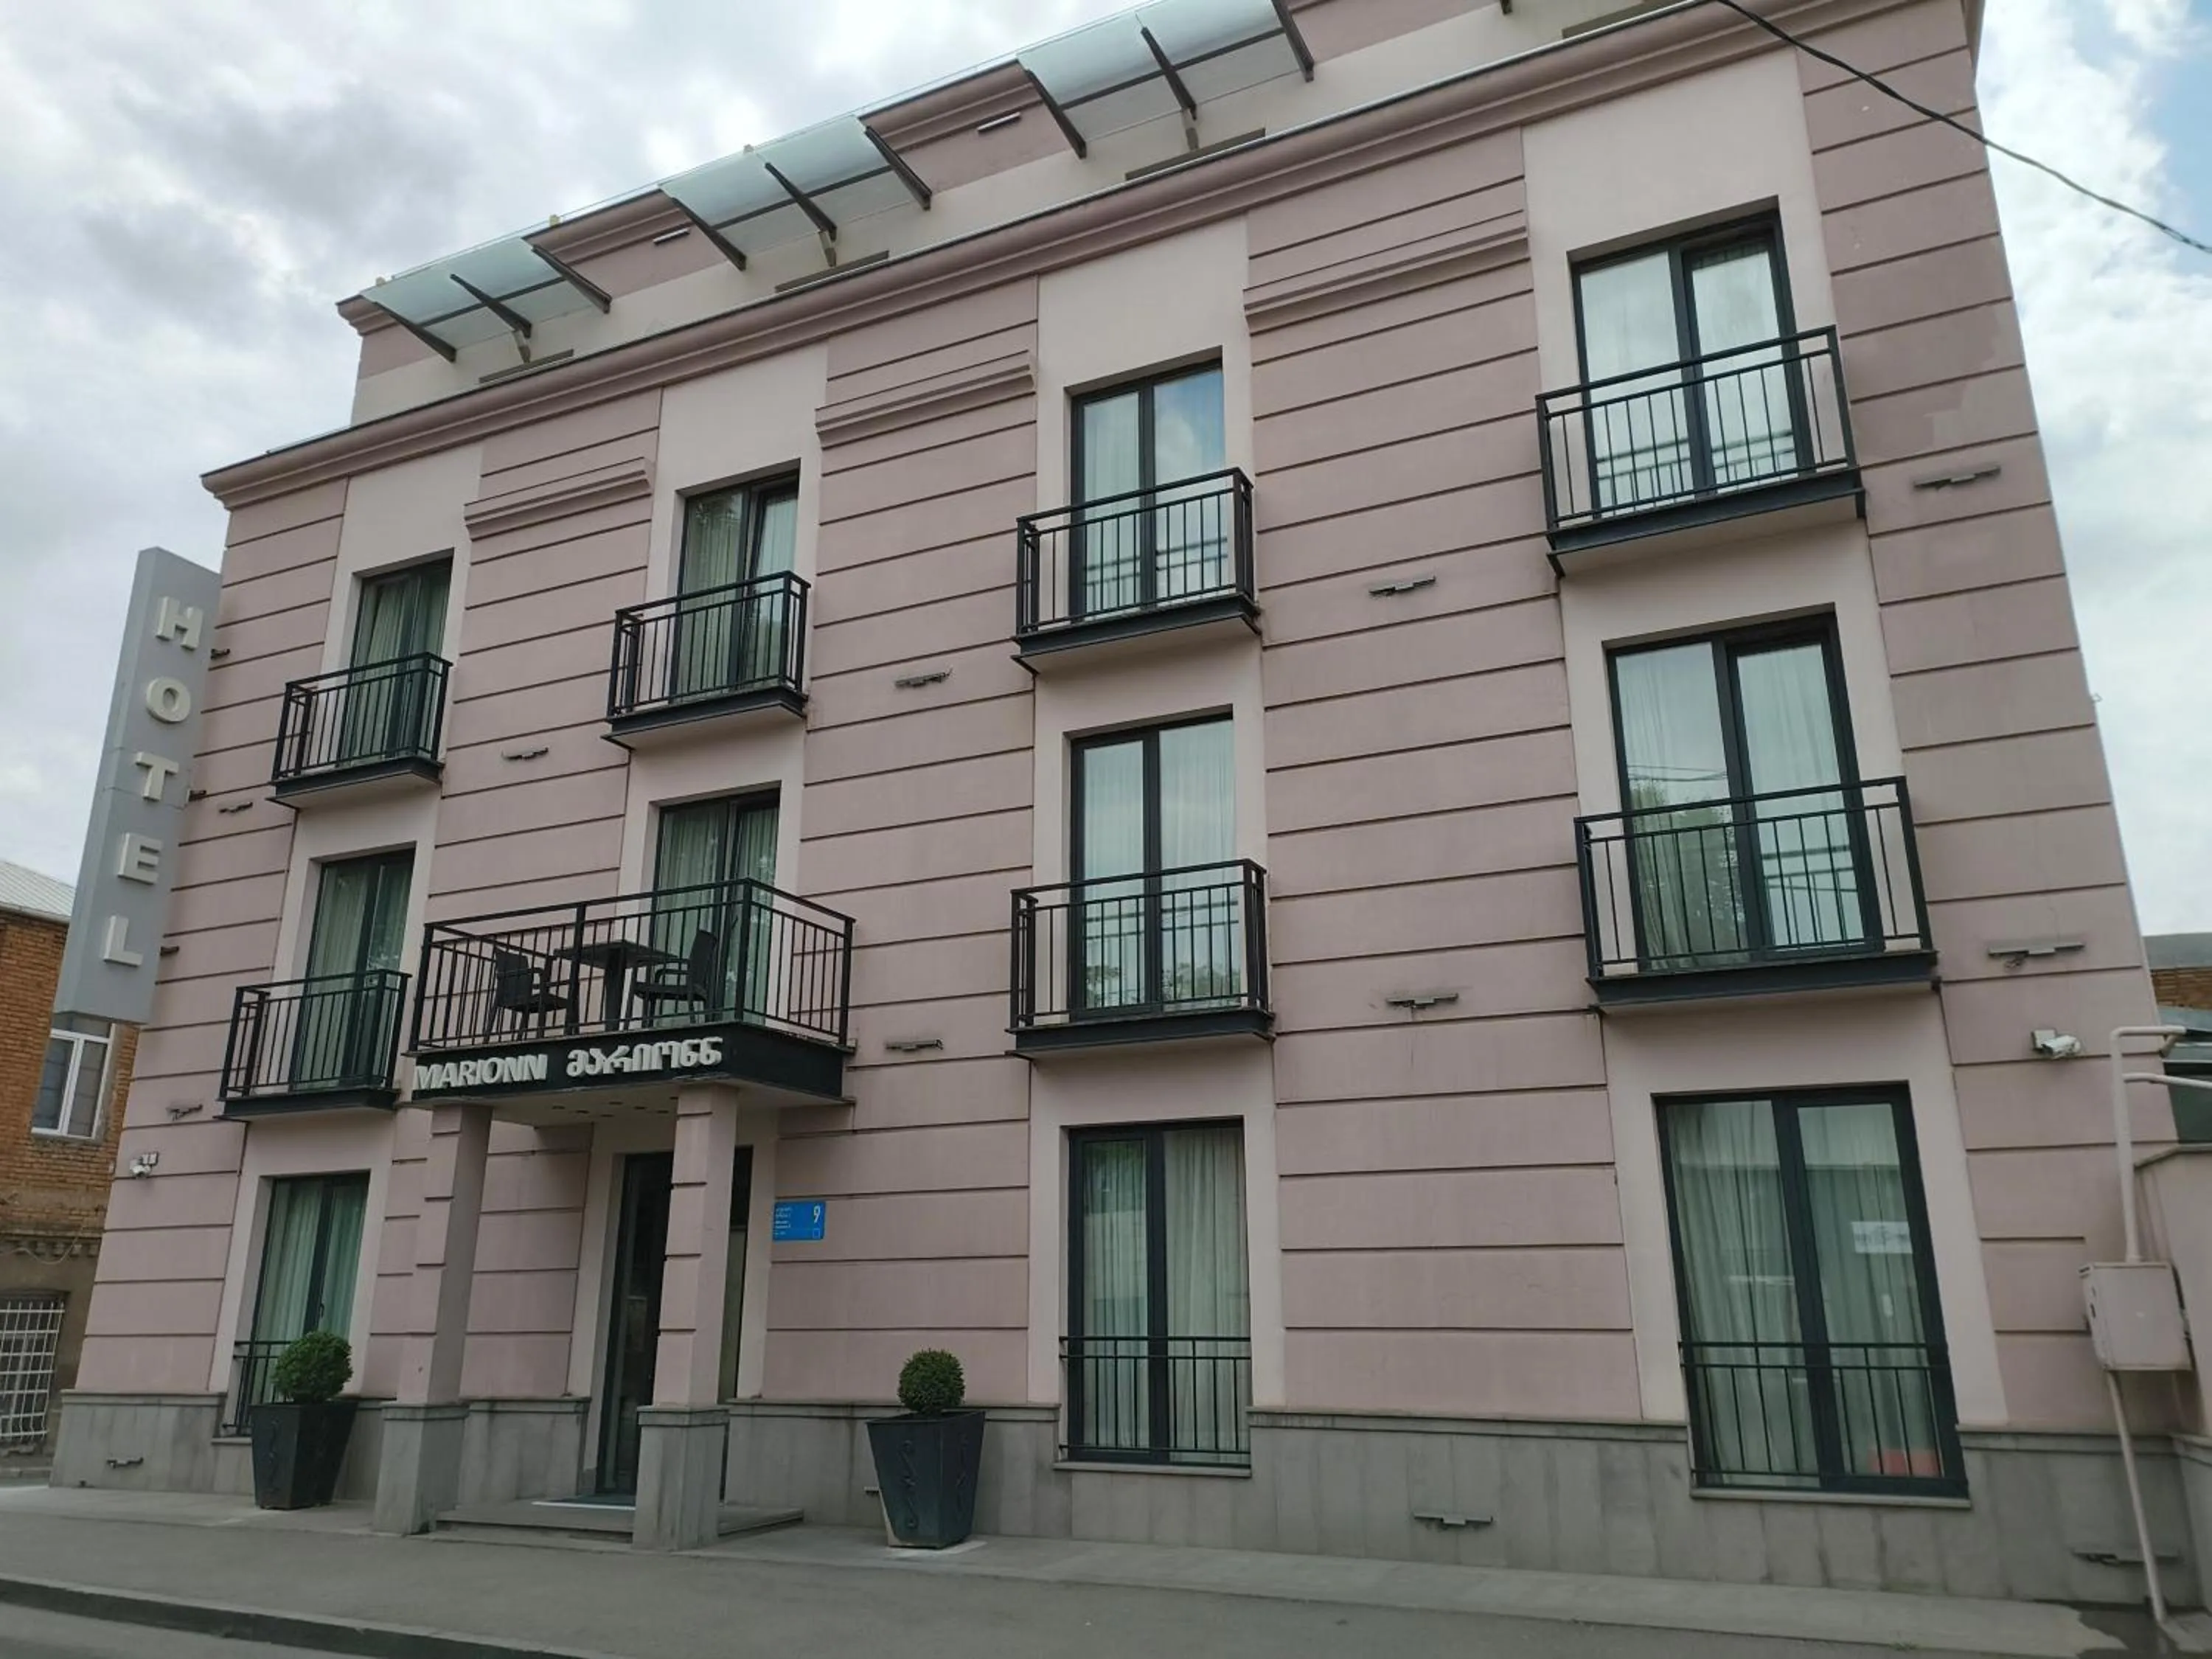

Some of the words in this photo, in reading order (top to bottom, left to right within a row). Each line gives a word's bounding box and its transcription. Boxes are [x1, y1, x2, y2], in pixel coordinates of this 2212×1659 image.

[103, 595, 204, 967] HOTEL
[413, 1054, 548, 1091] MARIONN
[813, 1206, 821, 1223] 9
